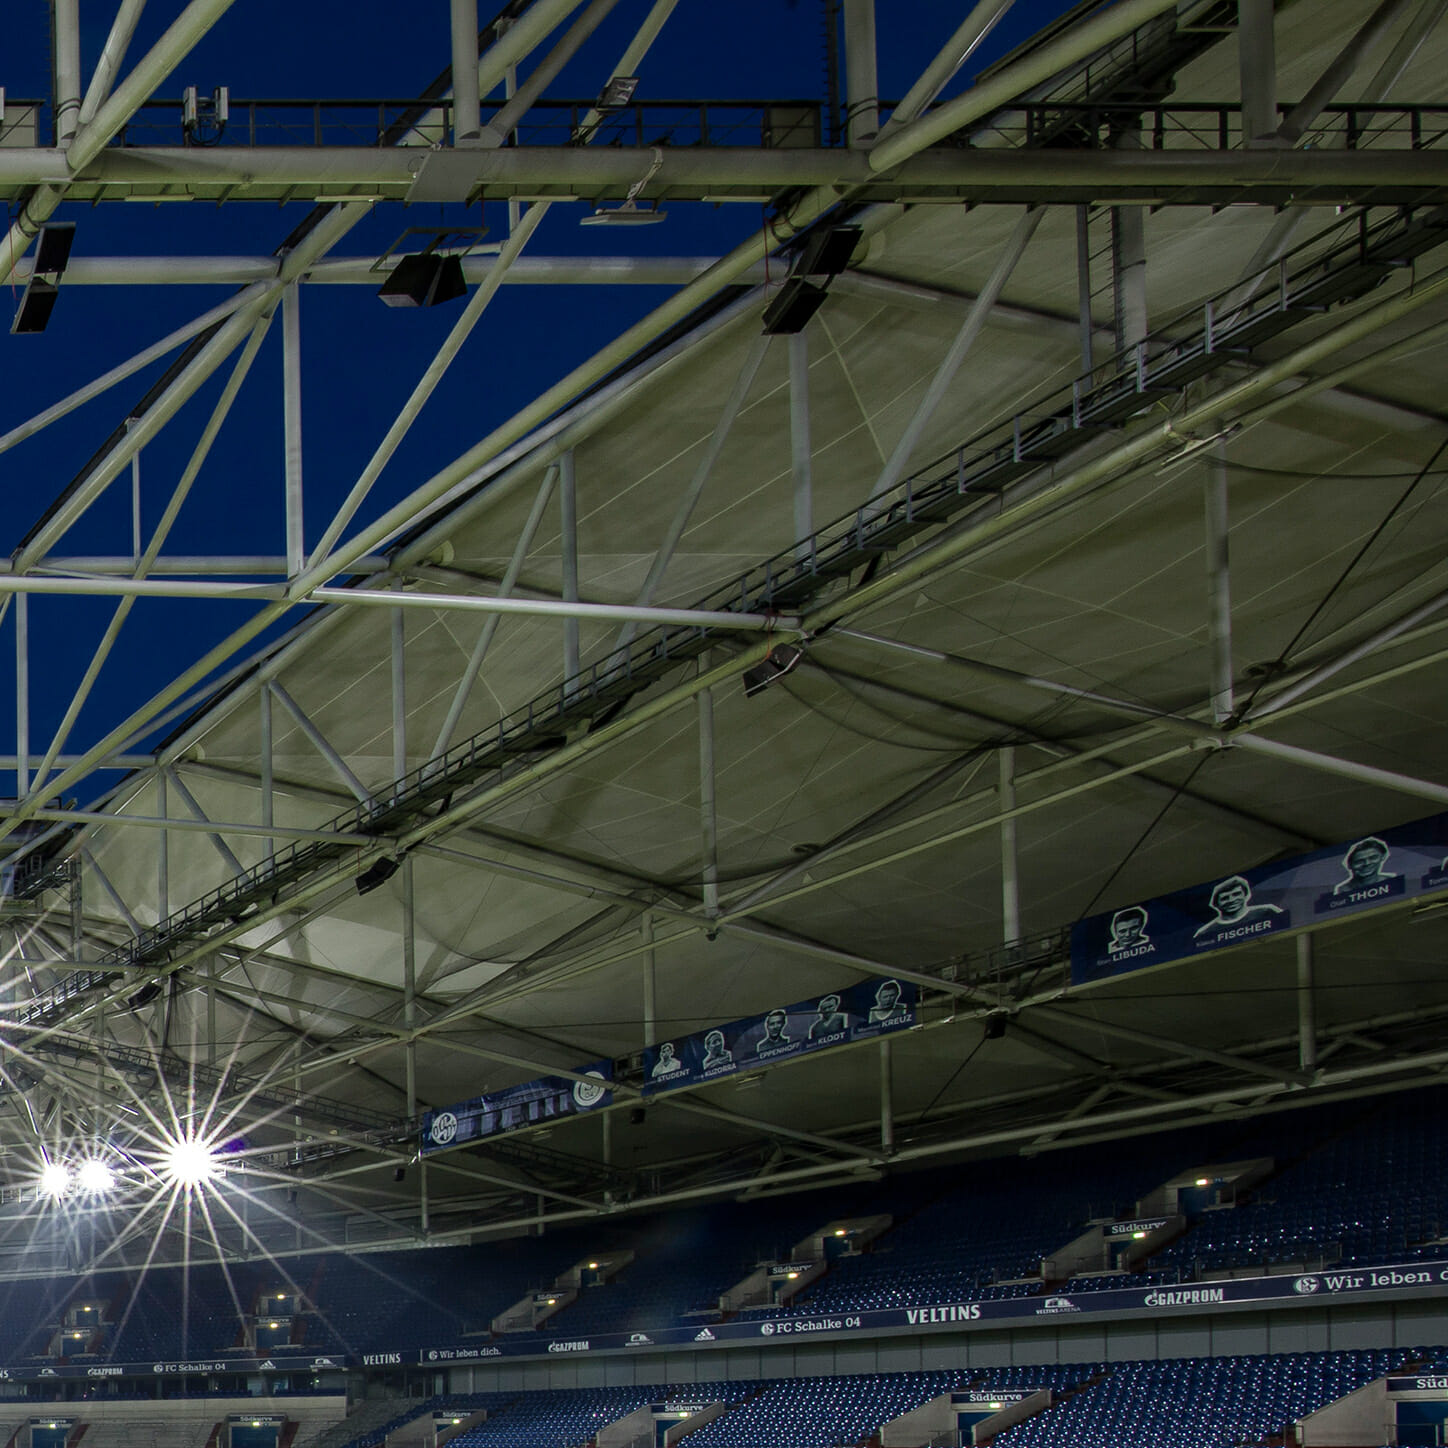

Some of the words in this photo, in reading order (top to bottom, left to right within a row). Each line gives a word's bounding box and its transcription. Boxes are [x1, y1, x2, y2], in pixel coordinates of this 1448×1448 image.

[1349, 884, 1390, 903] THON
[1217, 920, 1272, 942] FISCHER
[1113, 944, 1156, 962] LIBUDA
[881, 1014, 912, 1028] KREUZ
[818, 1031, 846, 1045] KLODT
[759, 1042, 801, 1059] EPPENHOFF
[656, 1068, 690, 1083] STUDENT
[1324, 1275, 1364, 1289] Wir
[1370, 1269, 1433, 1286] leben
[1158, 1288, 1224, 1305] GAZPROM
[906, 1305, 981, 1325] VELTINS
[777, 1322, 793, 1333] FC
[795, 1318, 842, 1332] Schalke
[845, 1316, 861, 1328] 04
[440, 1350, 454, 1360] Wir
[455, 1347, 479, 1358] leben
[480, 1346, 502, 1357] dich.
[554, 1341, 589, 1352] GAZPROM
[363, 1353, 401, 1366] VELTINS
[95, 1367, 123, 1376] GAZPROM
[178, 1363, 213, 1373] Schalke
[214, 1362, 226, 1371] 04
[969, 1392, 1022, 1402] Südkurve
[664, 1404, 704, 1412] Südkurve
